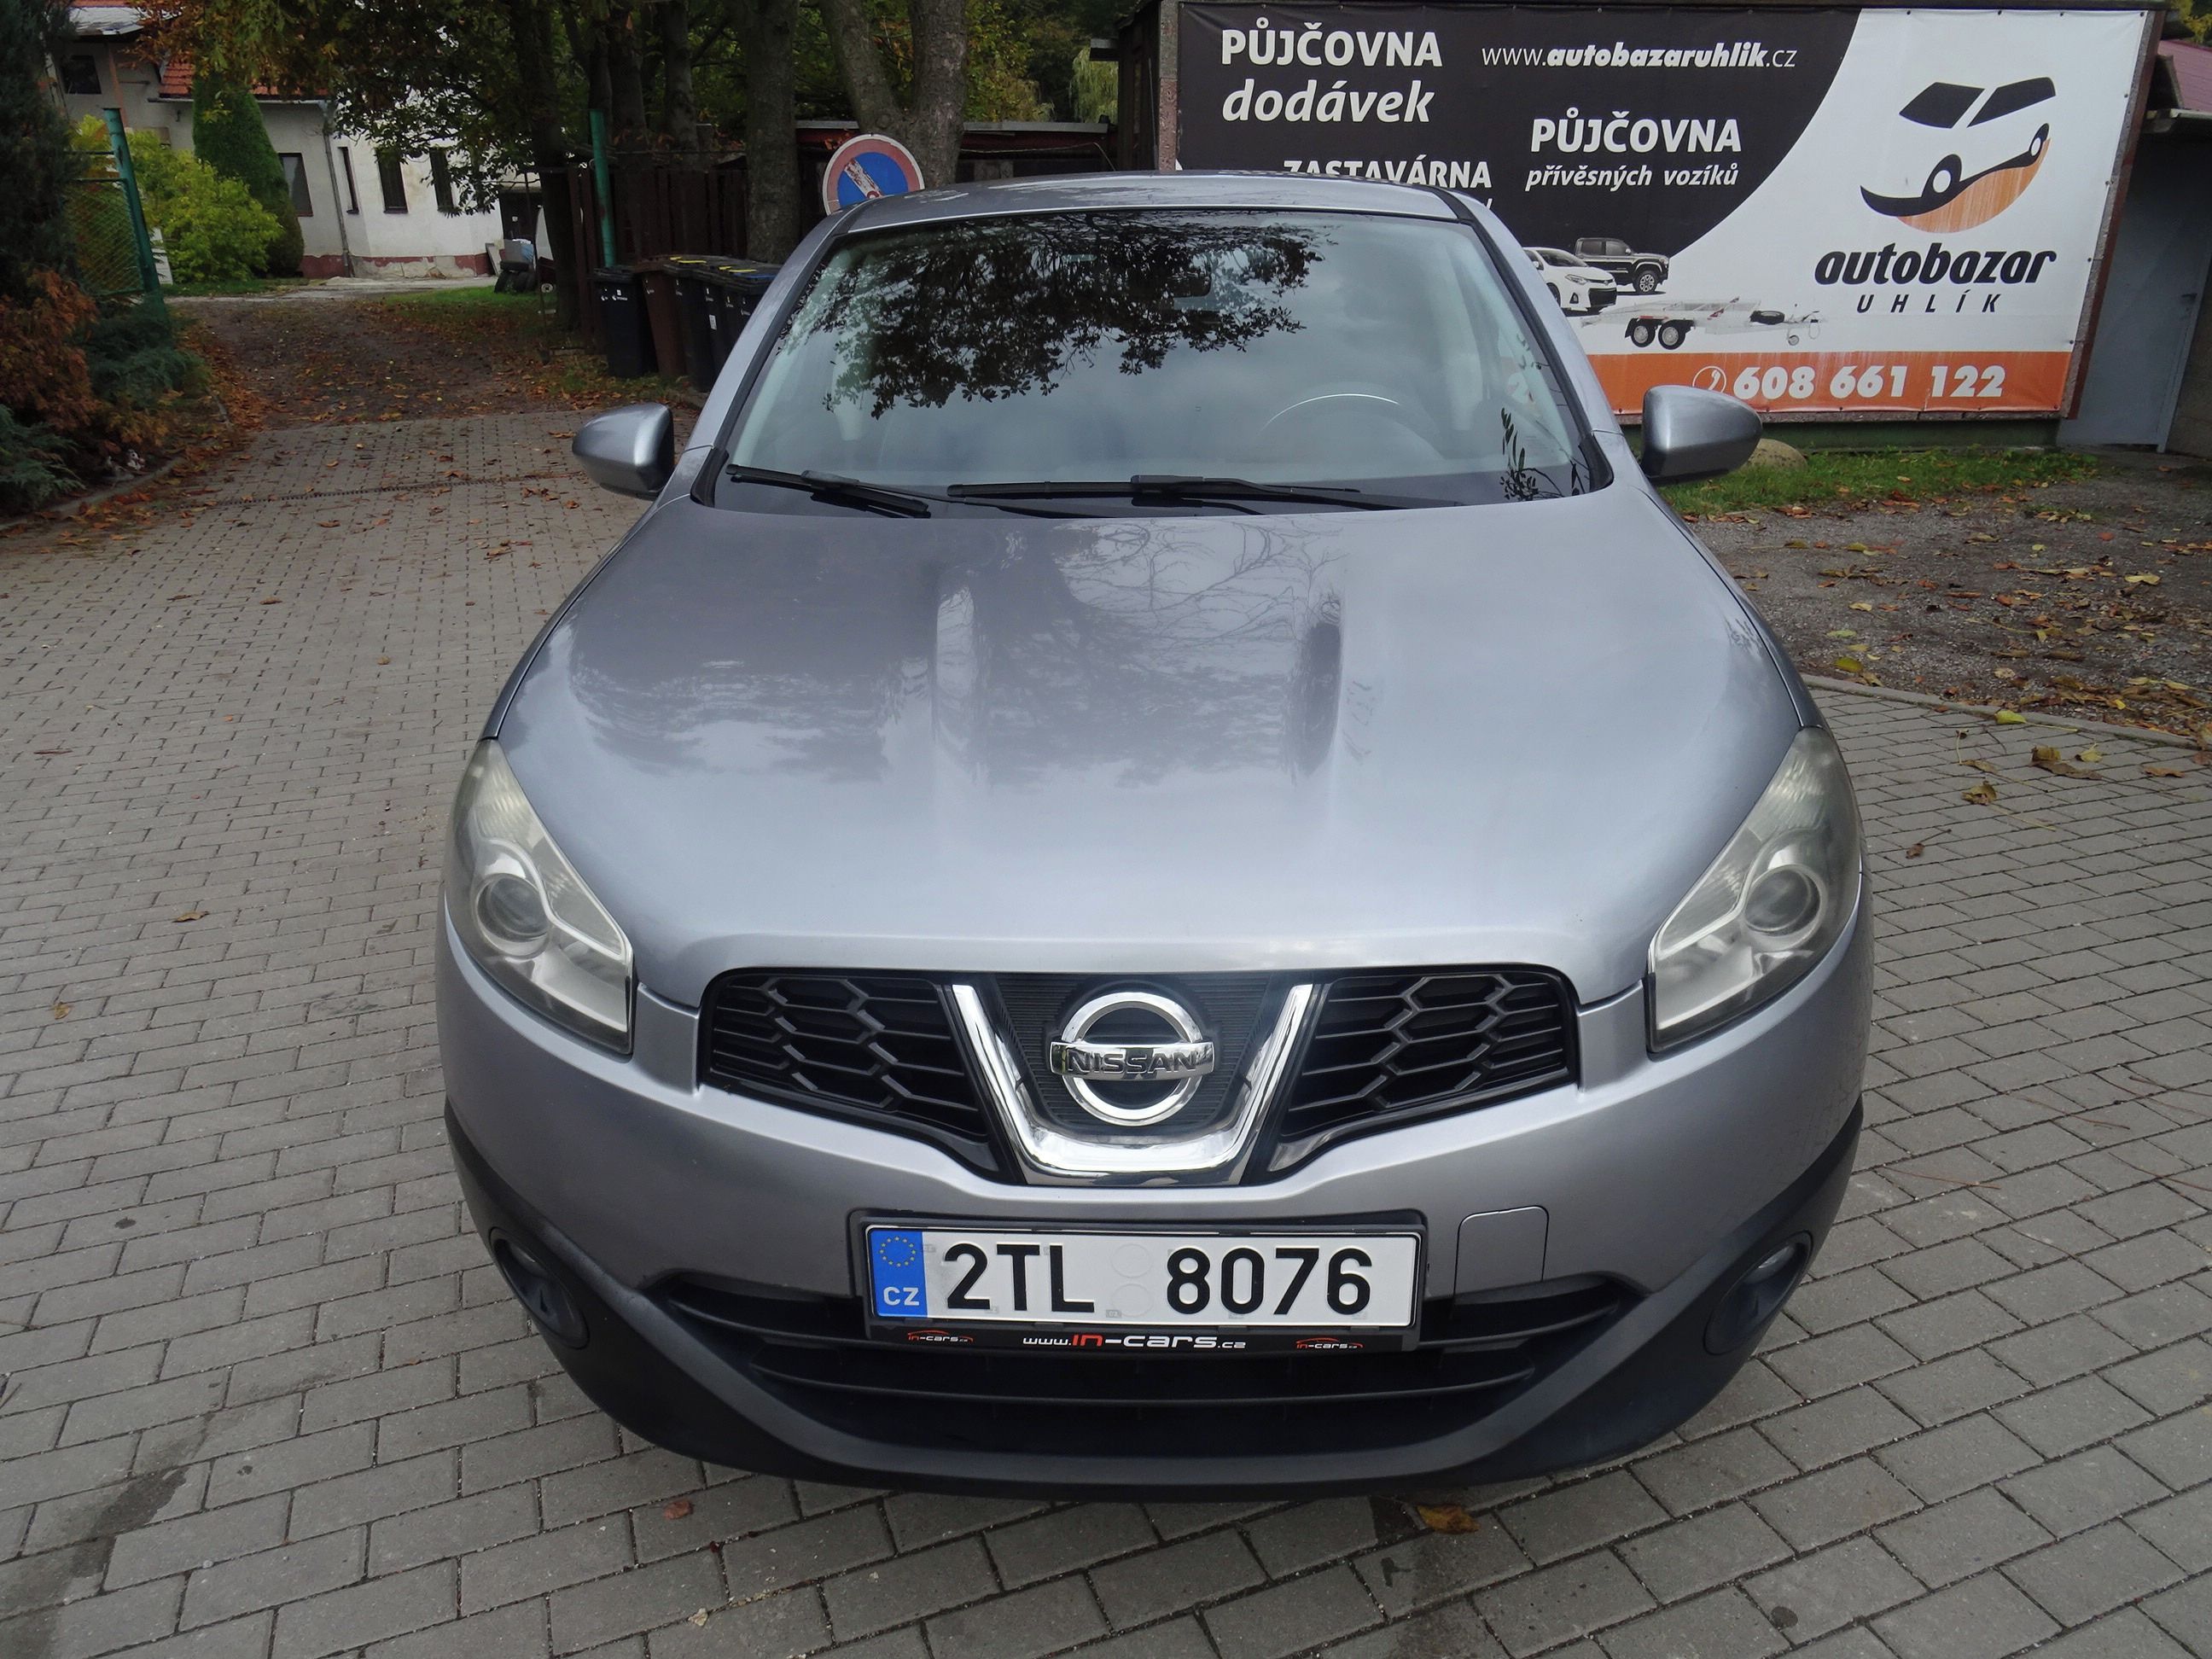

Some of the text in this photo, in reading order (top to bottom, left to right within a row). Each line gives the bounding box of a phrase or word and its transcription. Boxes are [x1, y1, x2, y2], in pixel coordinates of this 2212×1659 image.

[1221, 17, 1443, 67] PŮJČOVNA
[1222, 78, 1435, 124] dodávek
[1530, 108, 1742, 154] PŮJČOVNA
[1525, 164, 1738, 192] přívěsných vozíků
[1814, 242, 2057, 286] autobazar
[1732, 366, 2005, 399] 608 661 122
[1068, 1051, 1196, 1074] NISSAN
[882, 1287, 920, 1307] CZ
[944, 1243, 1372, 1315] 2TL 8076
